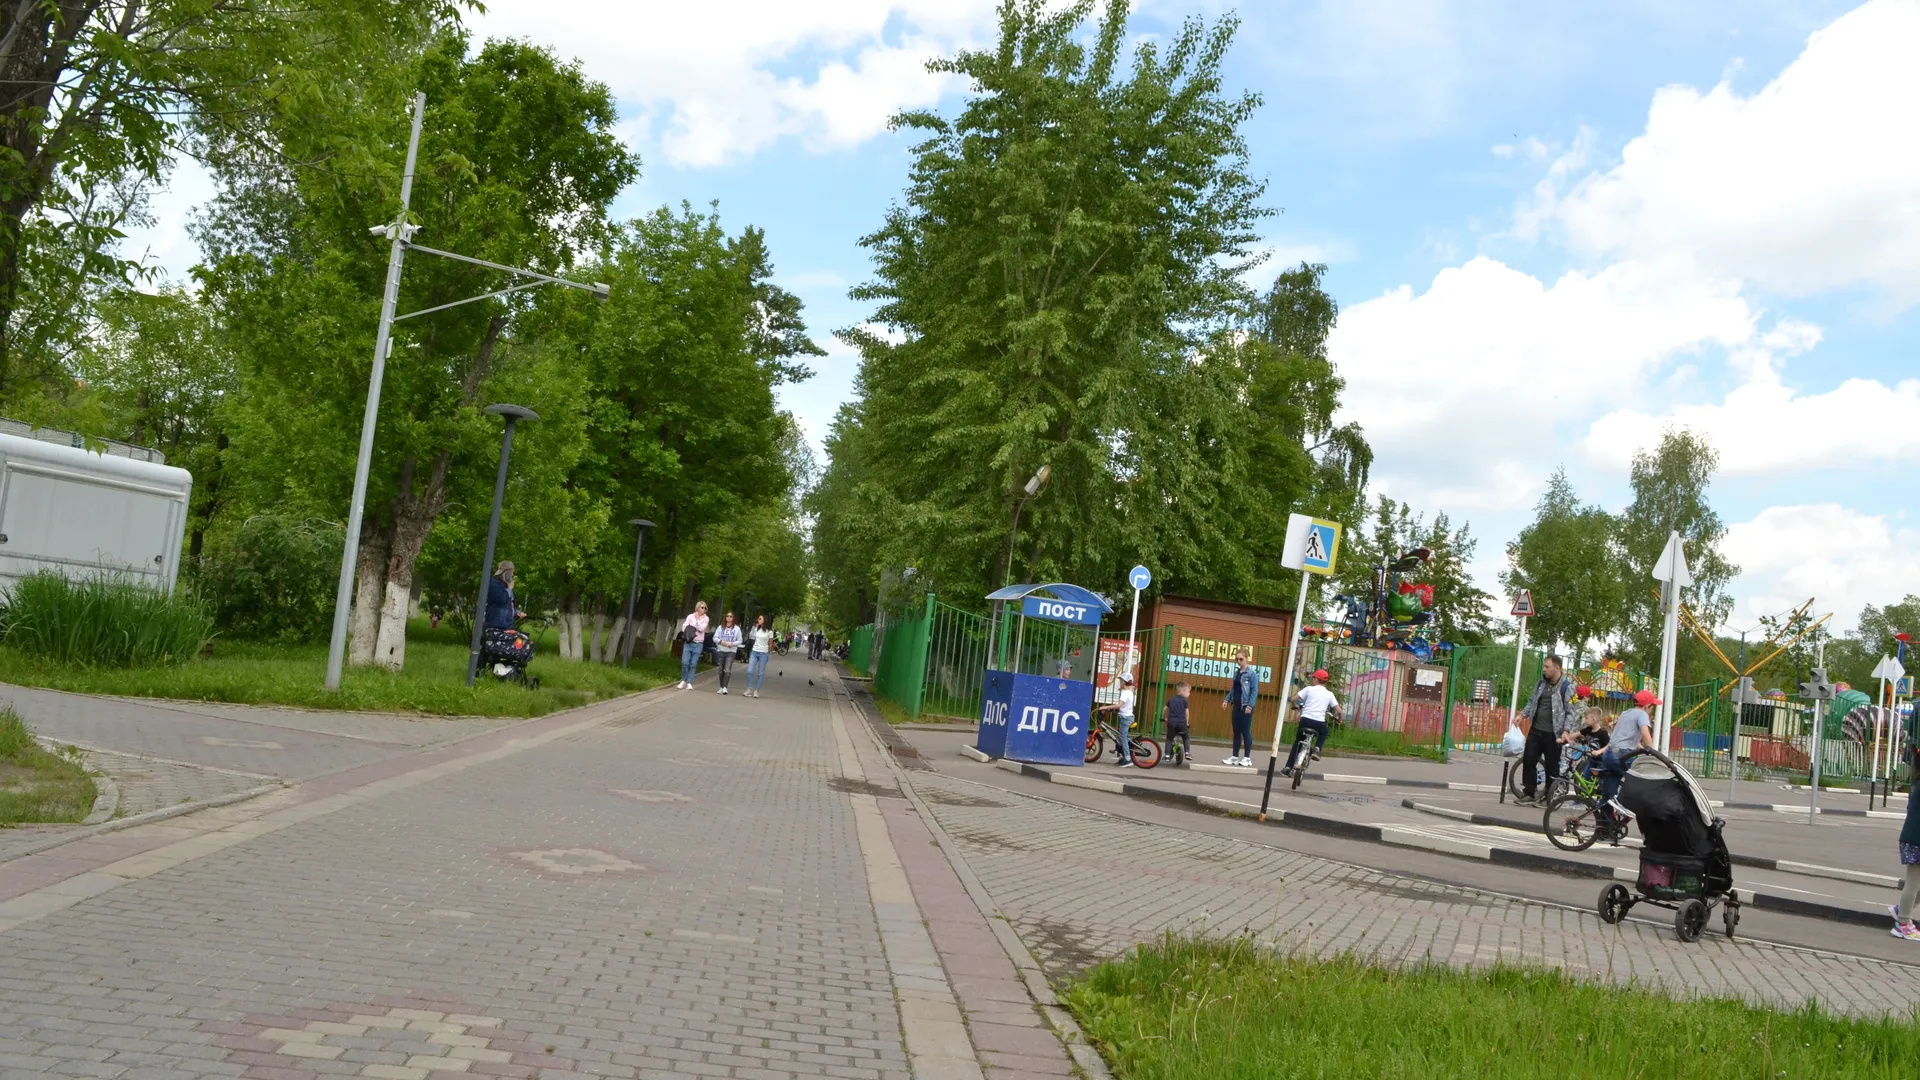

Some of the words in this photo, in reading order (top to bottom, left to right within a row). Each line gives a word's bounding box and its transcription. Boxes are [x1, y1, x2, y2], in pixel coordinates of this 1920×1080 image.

[1038, 602, 1087, 620] ПОСТ
[1166, 658, 1269, 679] 9260100
[982, 700, 1008, 726] ДПС
[1017, 705, 1080, 735] ДПС
